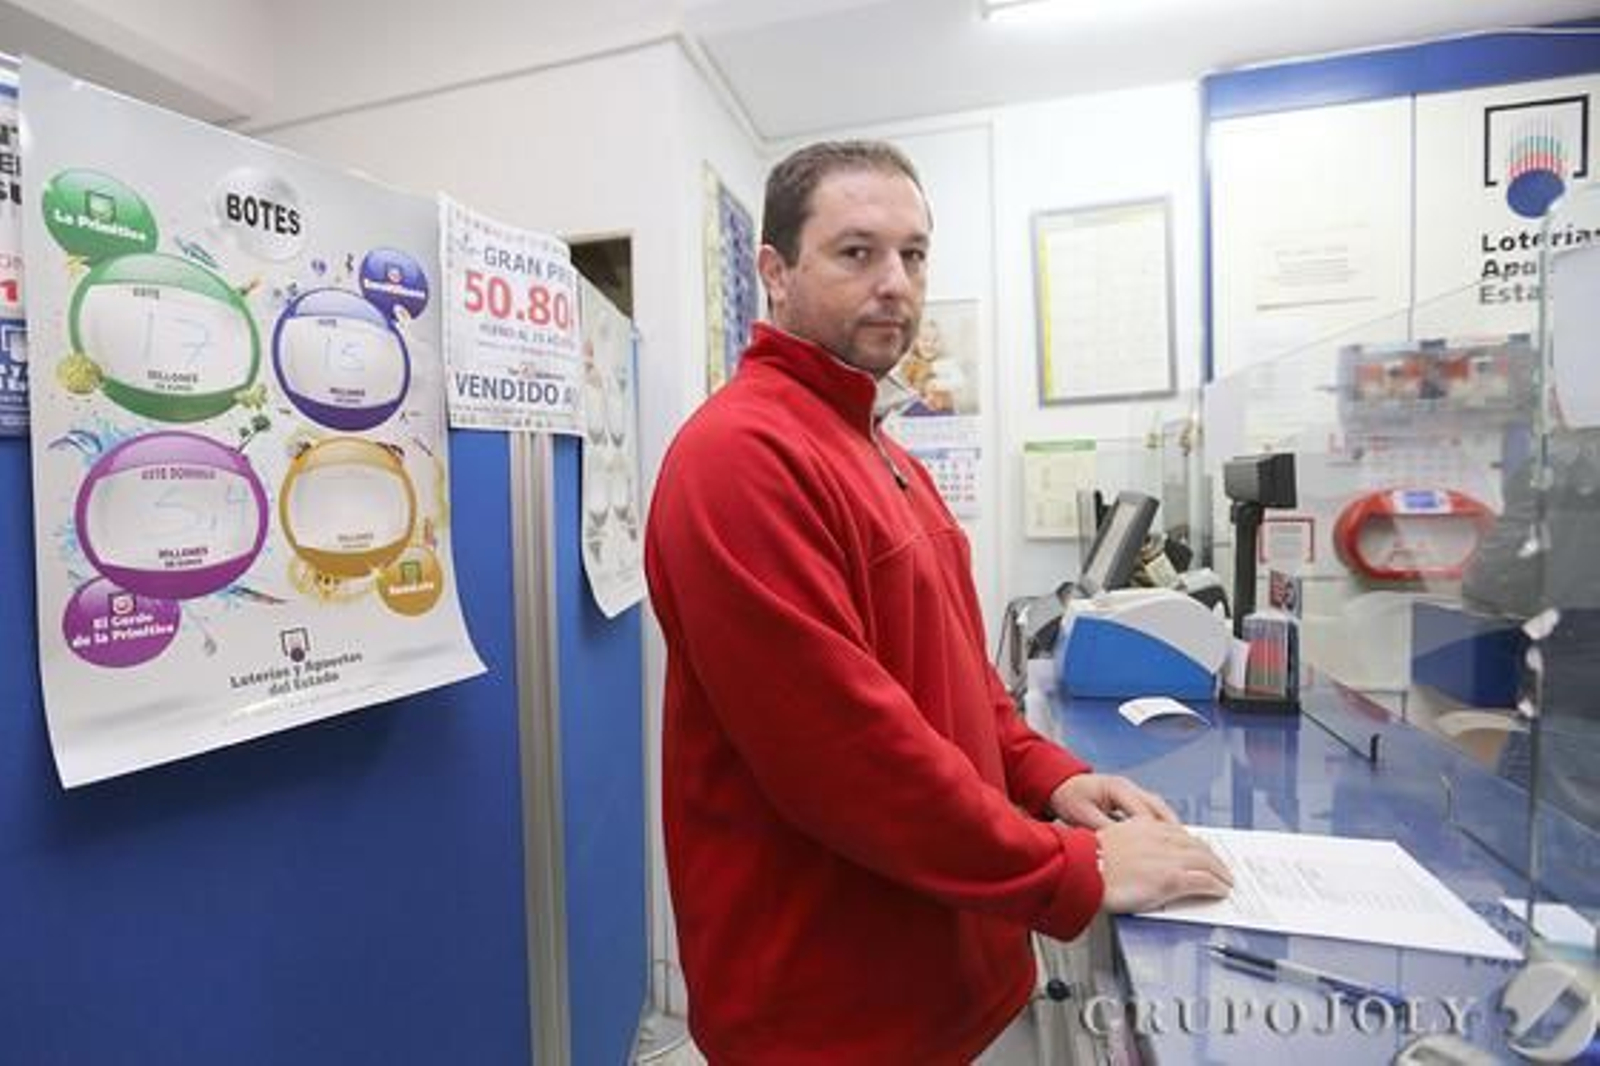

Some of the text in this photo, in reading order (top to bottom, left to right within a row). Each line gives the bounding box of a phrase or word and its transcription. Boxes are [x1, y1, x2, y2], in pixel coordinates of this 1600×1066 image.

[226, 193, 301, 236] BOTES
[484, 246, 541, 275] GRAN
[455, 373, 560, 406] VENDIDO
[111, 612, 154, 626] Gordo
